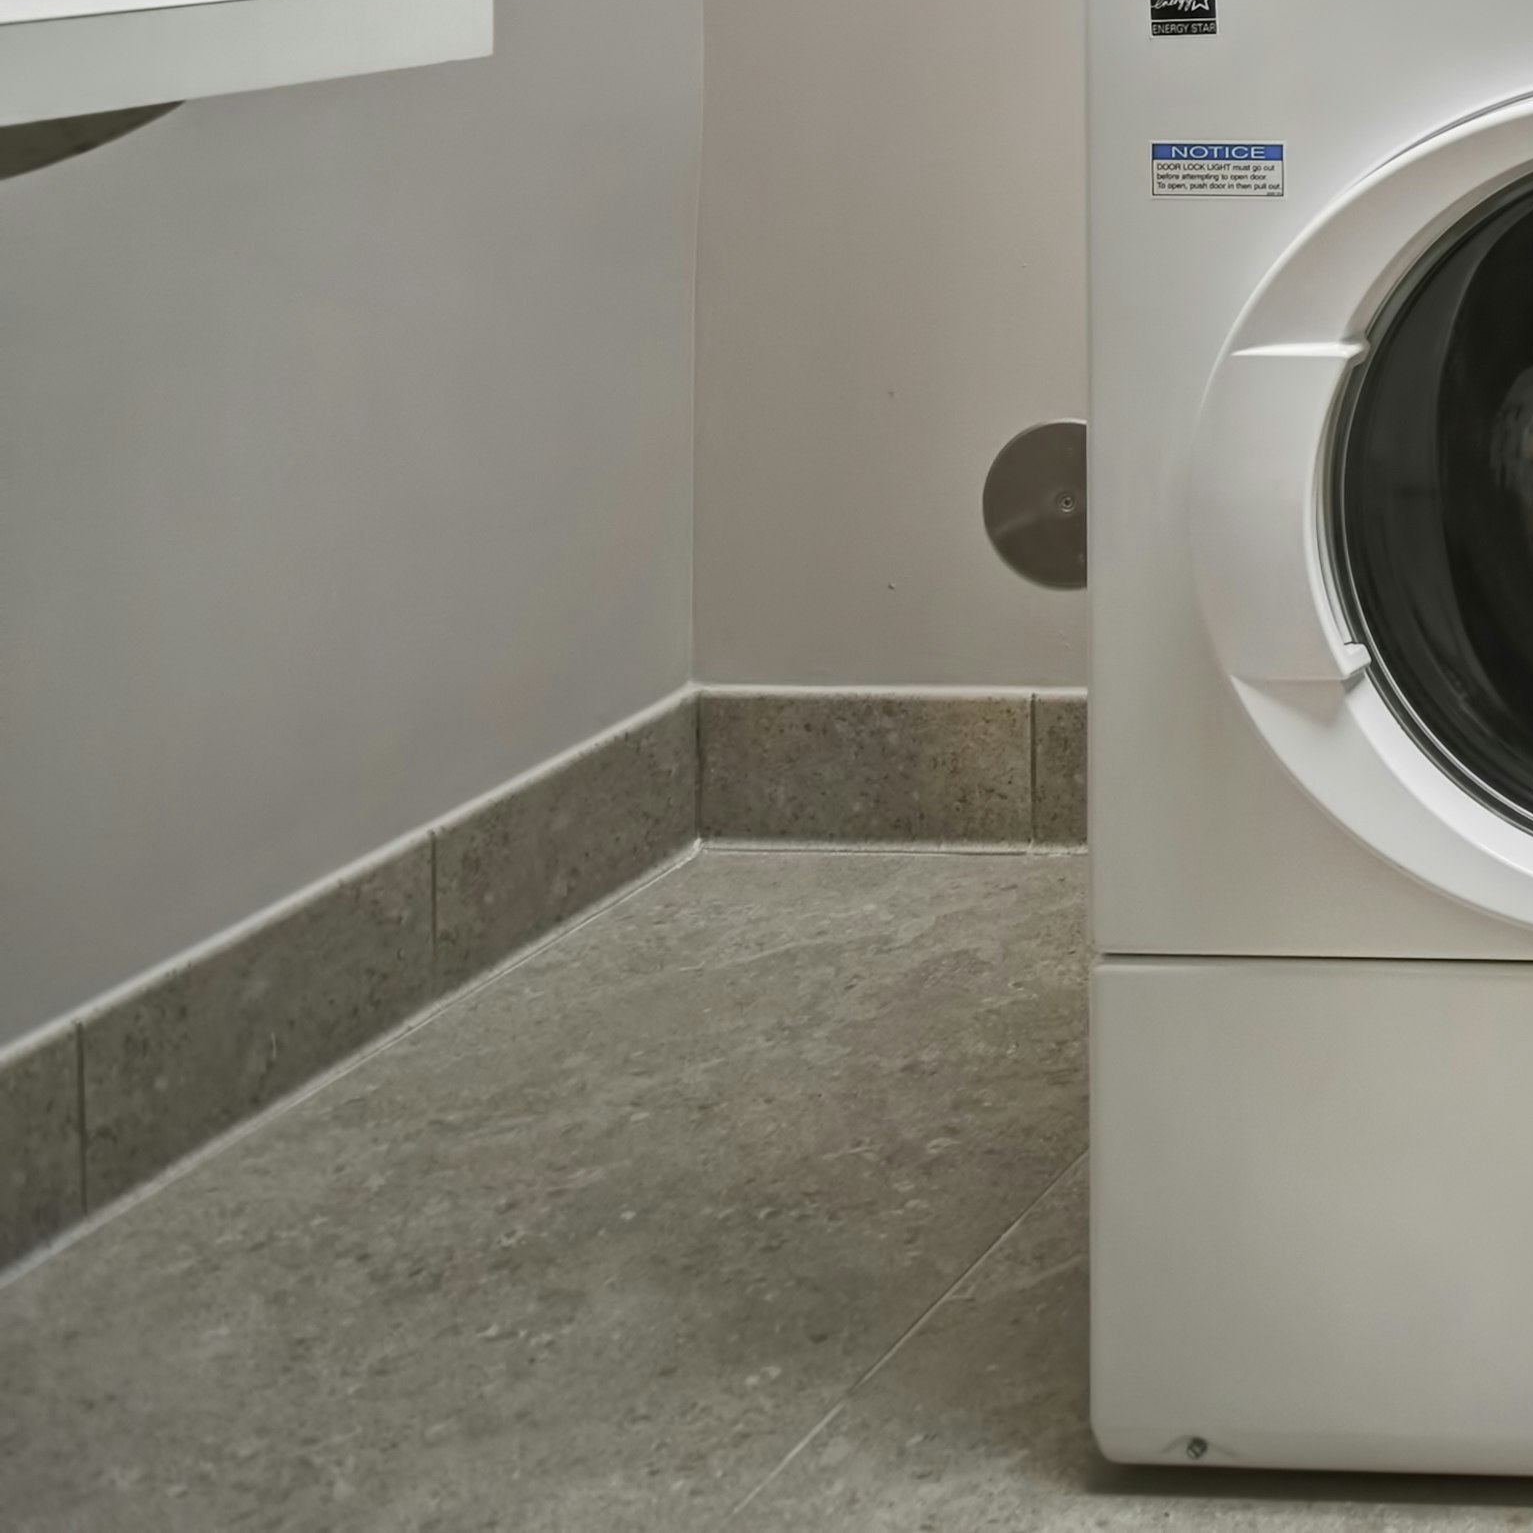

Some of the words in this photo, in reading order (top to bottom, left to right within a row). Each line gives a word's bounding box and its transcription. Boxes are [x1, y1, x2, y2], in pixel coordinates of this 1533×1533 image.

[1153, 24, 1188, 34] ENERGY
[1191, 23, 1215, 33] STAR
[1172, 146, 1265, 158] NOTICE
[1182, 173, 1219, 181] attempting
